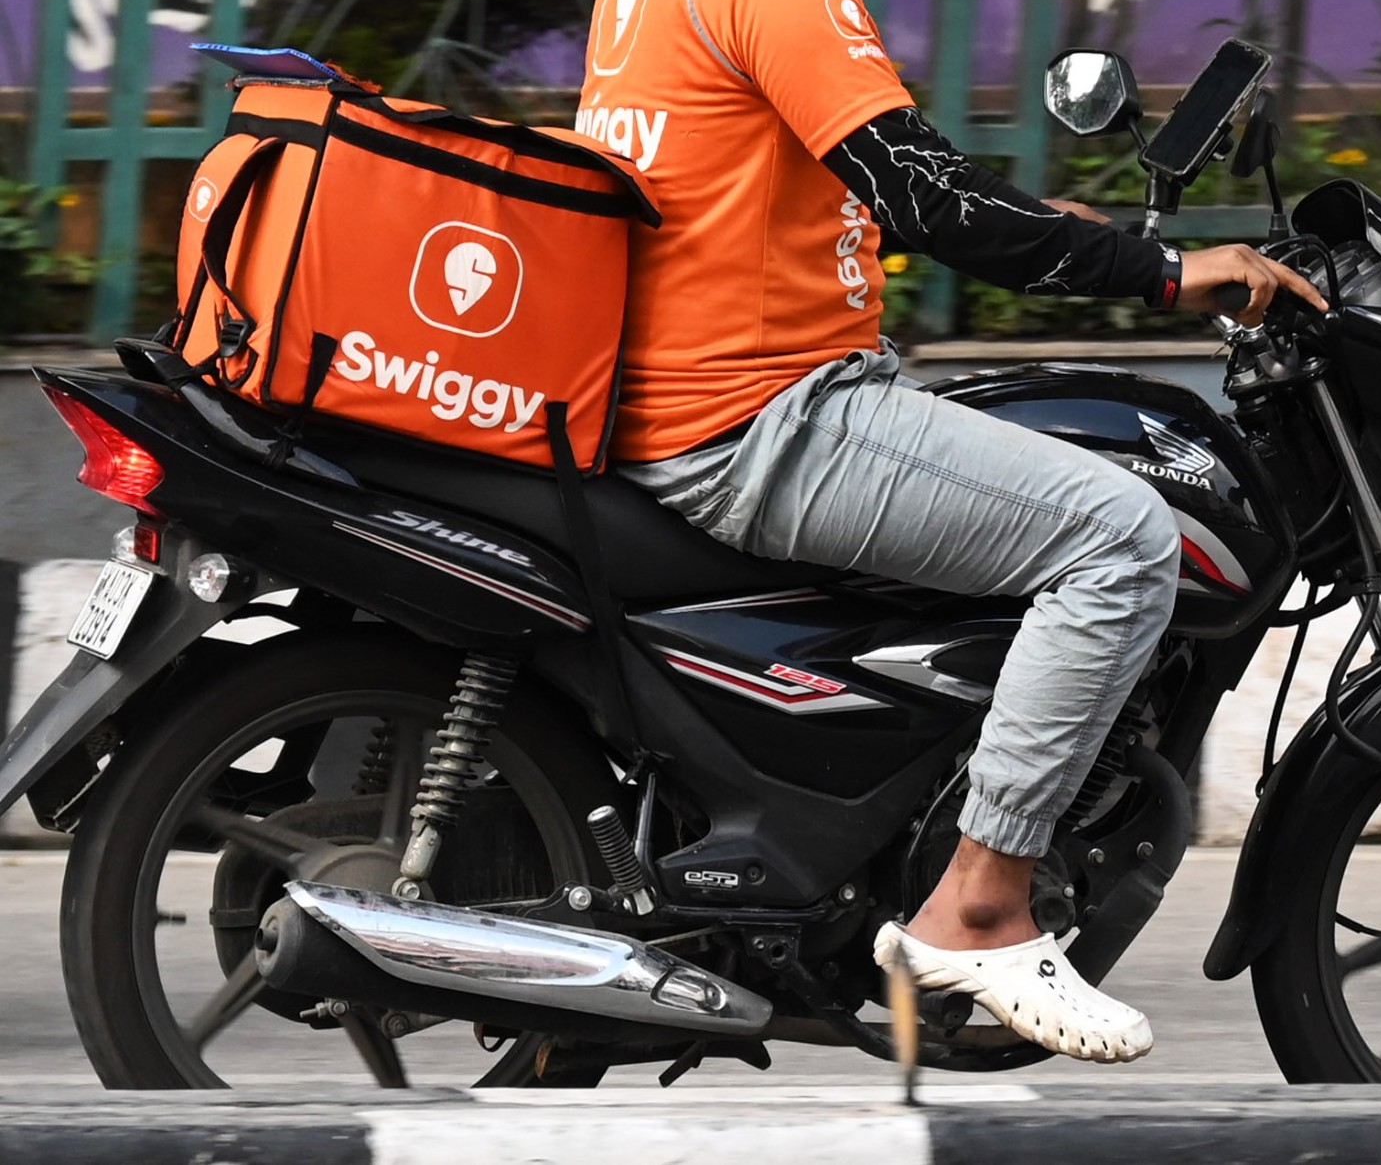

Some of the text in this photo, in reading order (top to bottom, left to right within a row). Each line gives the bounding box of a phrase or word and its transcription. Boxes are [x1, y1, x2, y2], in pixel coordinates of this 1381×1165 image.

[334, 331, 546, 434] Swiggy
[1130, 459, 1213, 491] HONDA
[368, 510, 536, 568] Shine
[763, 663, 847, 694] 125
